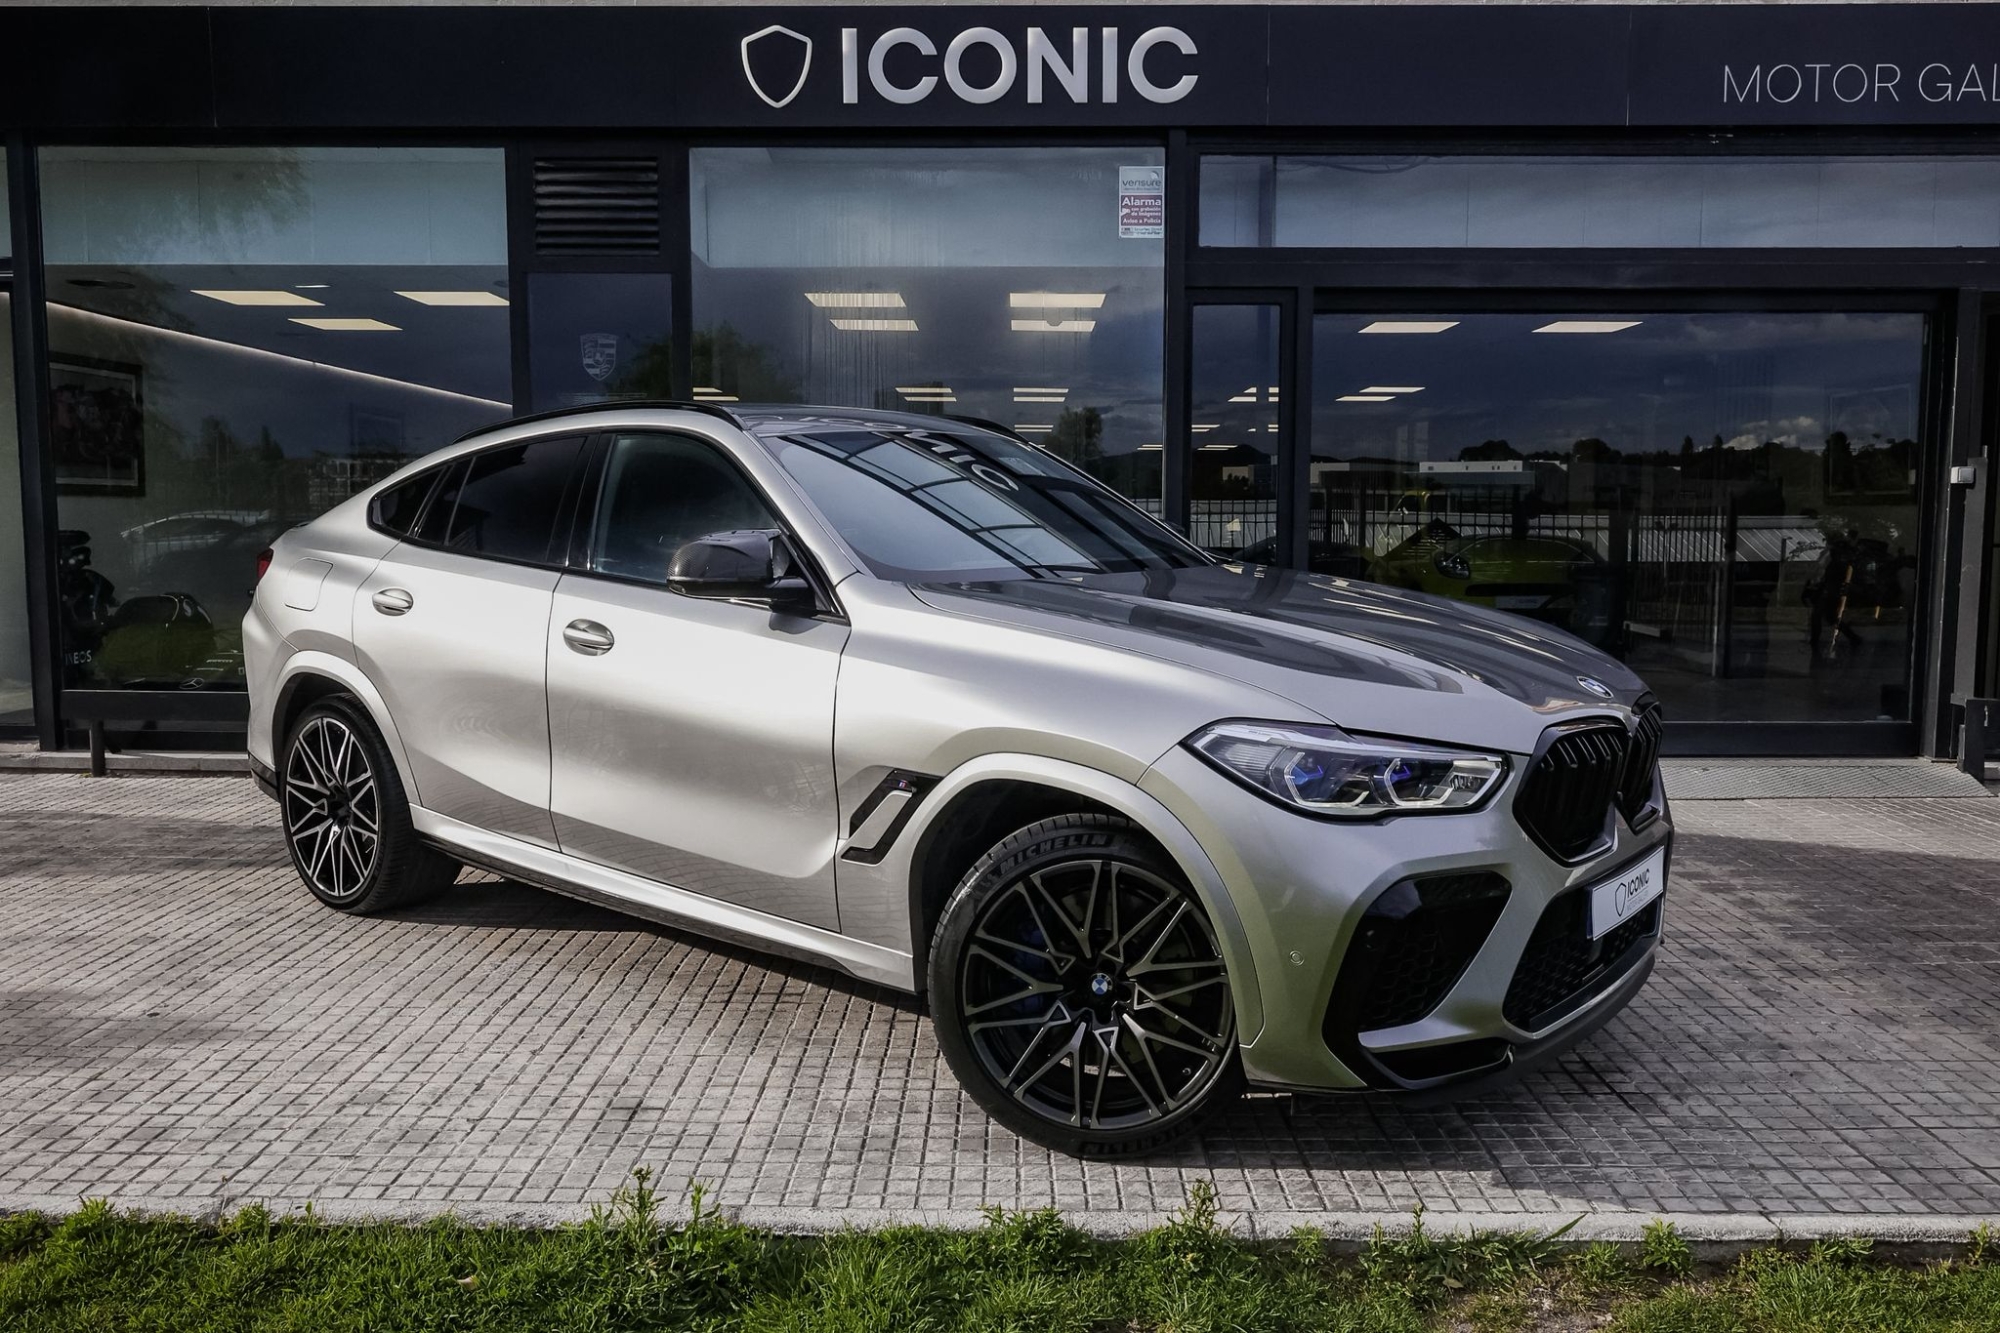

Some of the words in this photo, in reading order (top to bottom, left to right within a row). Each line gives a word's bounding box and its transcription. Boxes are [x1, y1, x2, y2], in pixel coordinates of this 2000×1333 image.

[841, 26, 1199, 104] ICONIC
[1723, 63, 1901, 103] MOTOR
[1122, 197, 1161, 206] Alarma
[999, 834, 1108, 874] MICHELIN
[1627, 868, 1650, 898] ICONIC
